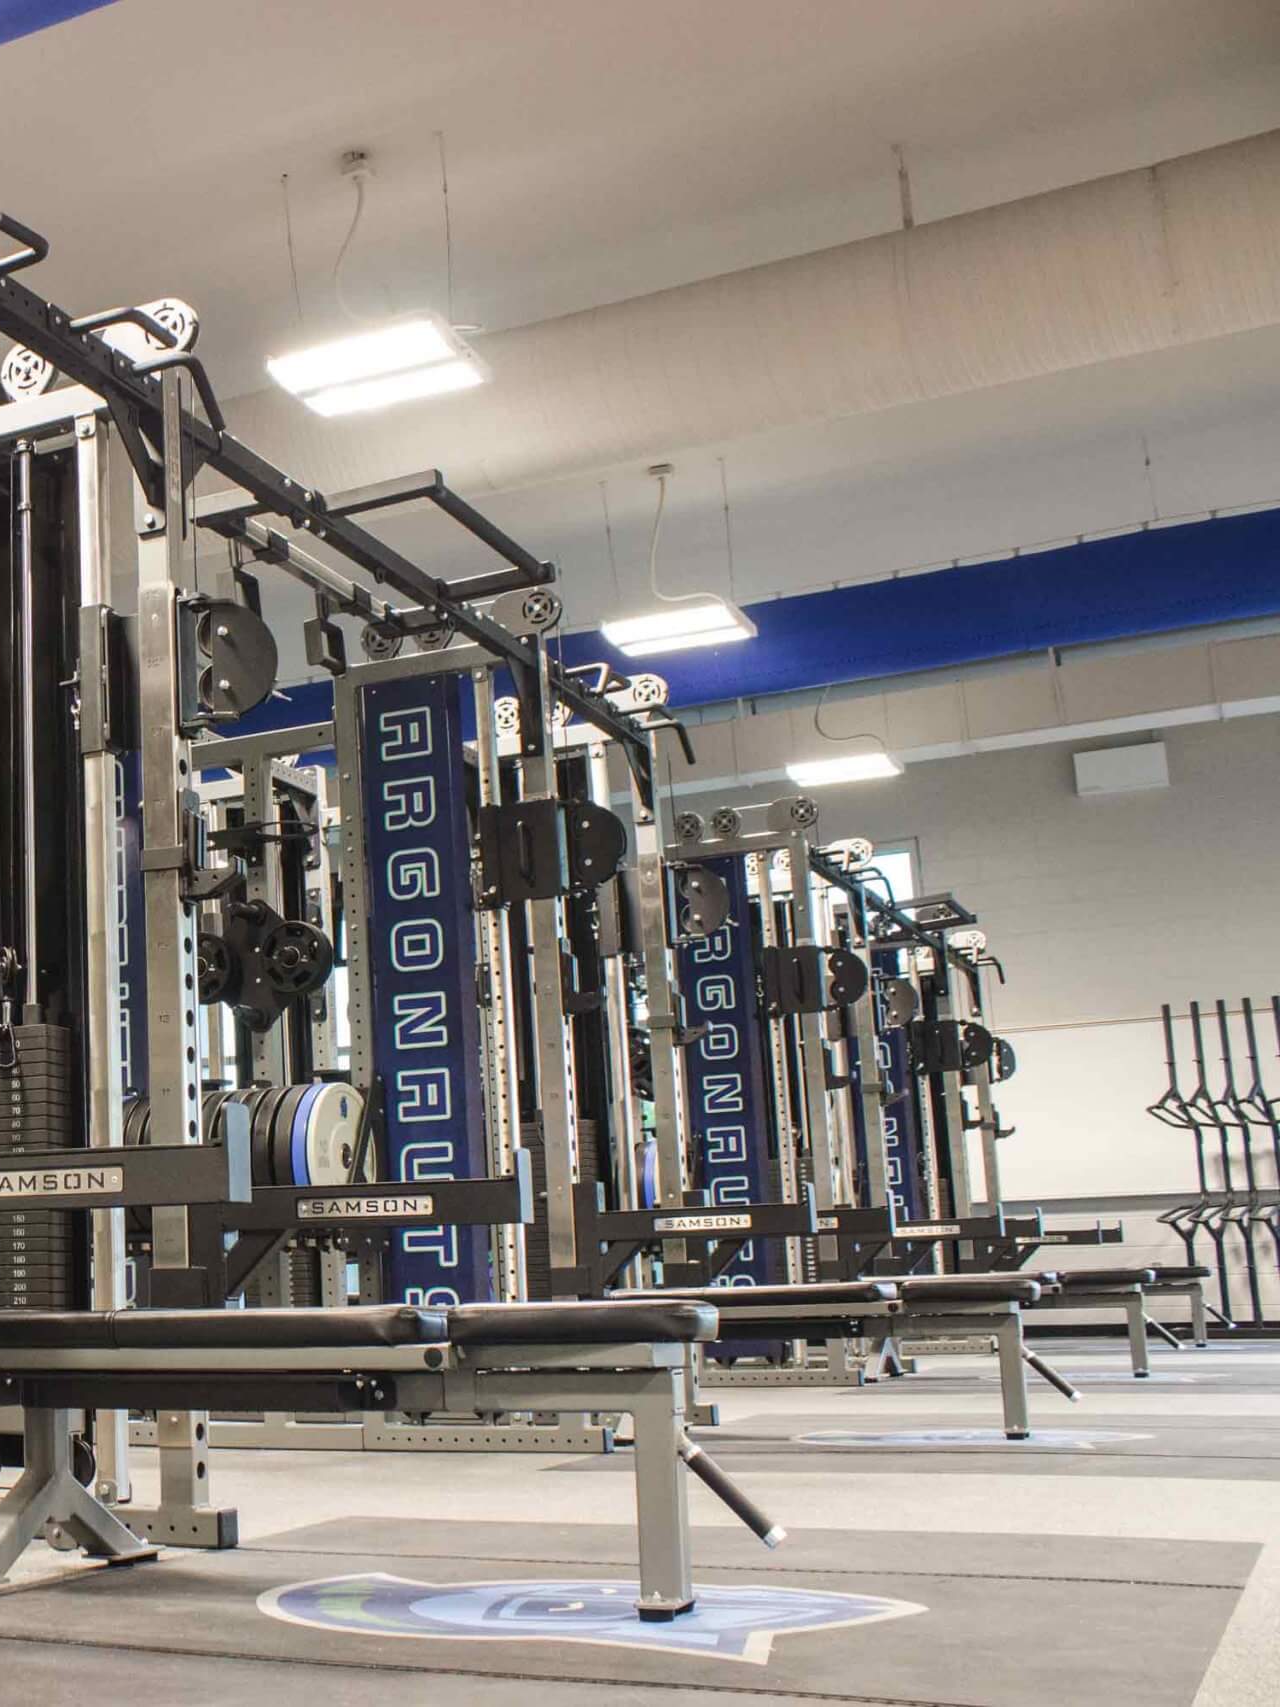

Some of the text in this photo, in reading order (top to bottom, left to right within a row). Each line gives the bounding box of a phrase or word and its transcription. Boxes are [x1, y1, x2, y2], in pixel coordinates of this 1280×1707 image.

[311, 1199, 418, 1214] SAMSON
[664, 1216, 741, 1228] SAMSON
[12, 1241, 26, 1250] 170
[13, 1296, 27, 1305] 210
